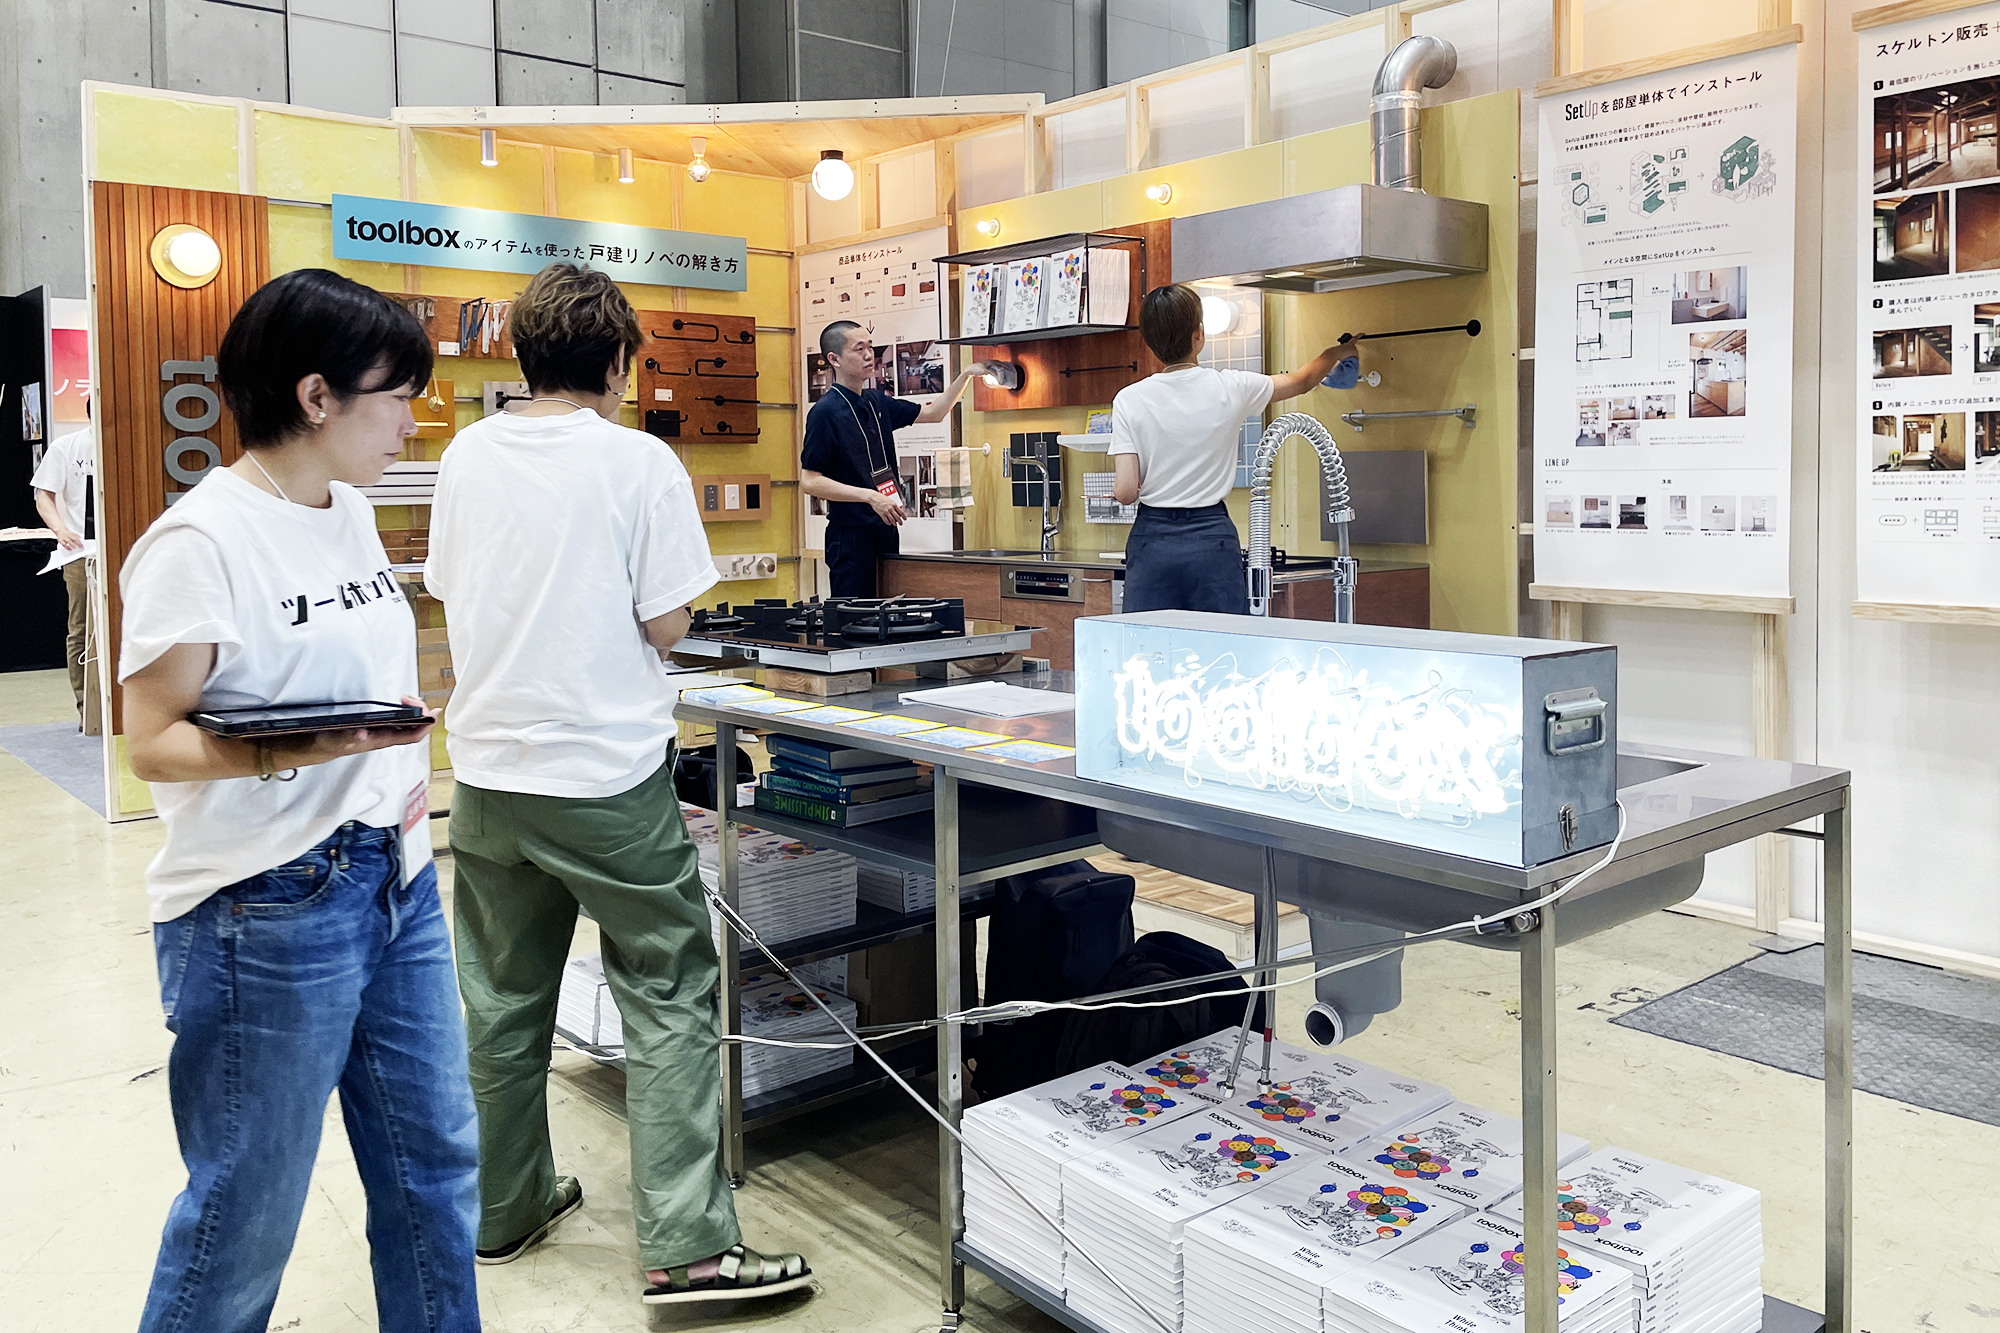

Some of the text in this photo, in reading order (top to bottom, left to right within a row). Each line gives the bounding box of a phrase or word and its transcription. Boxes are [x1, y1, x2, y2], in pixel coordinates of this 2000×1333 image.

[1565, 71, 1762, 121] SetUpを部屋単体でインストール
[1545, 458, 1570, 467] LINE UP
[775, 795, 830, 821] SIMPLISSIME
[1104, 1065, 1136, 1081] toolbox
[1188, 1091, 1222, 1105] toolbox
[1208, 1112, 1243, 1131] toolbox
[1296, 1126, 1335, 1143] toolbox
[1327, 1160, 1368, 1180] toolbox
[1434, 1183, 1478, 1200] toolbox
[1477, 1218, 1522, 1239] toolbox
[1299, 1246, 1320, 1258] While
[1594, 1237, 1644, 1256] toolbox
[1291, 1251, 1324, 1268] Thinking
[1452, 1314, 1477, 1328] While
